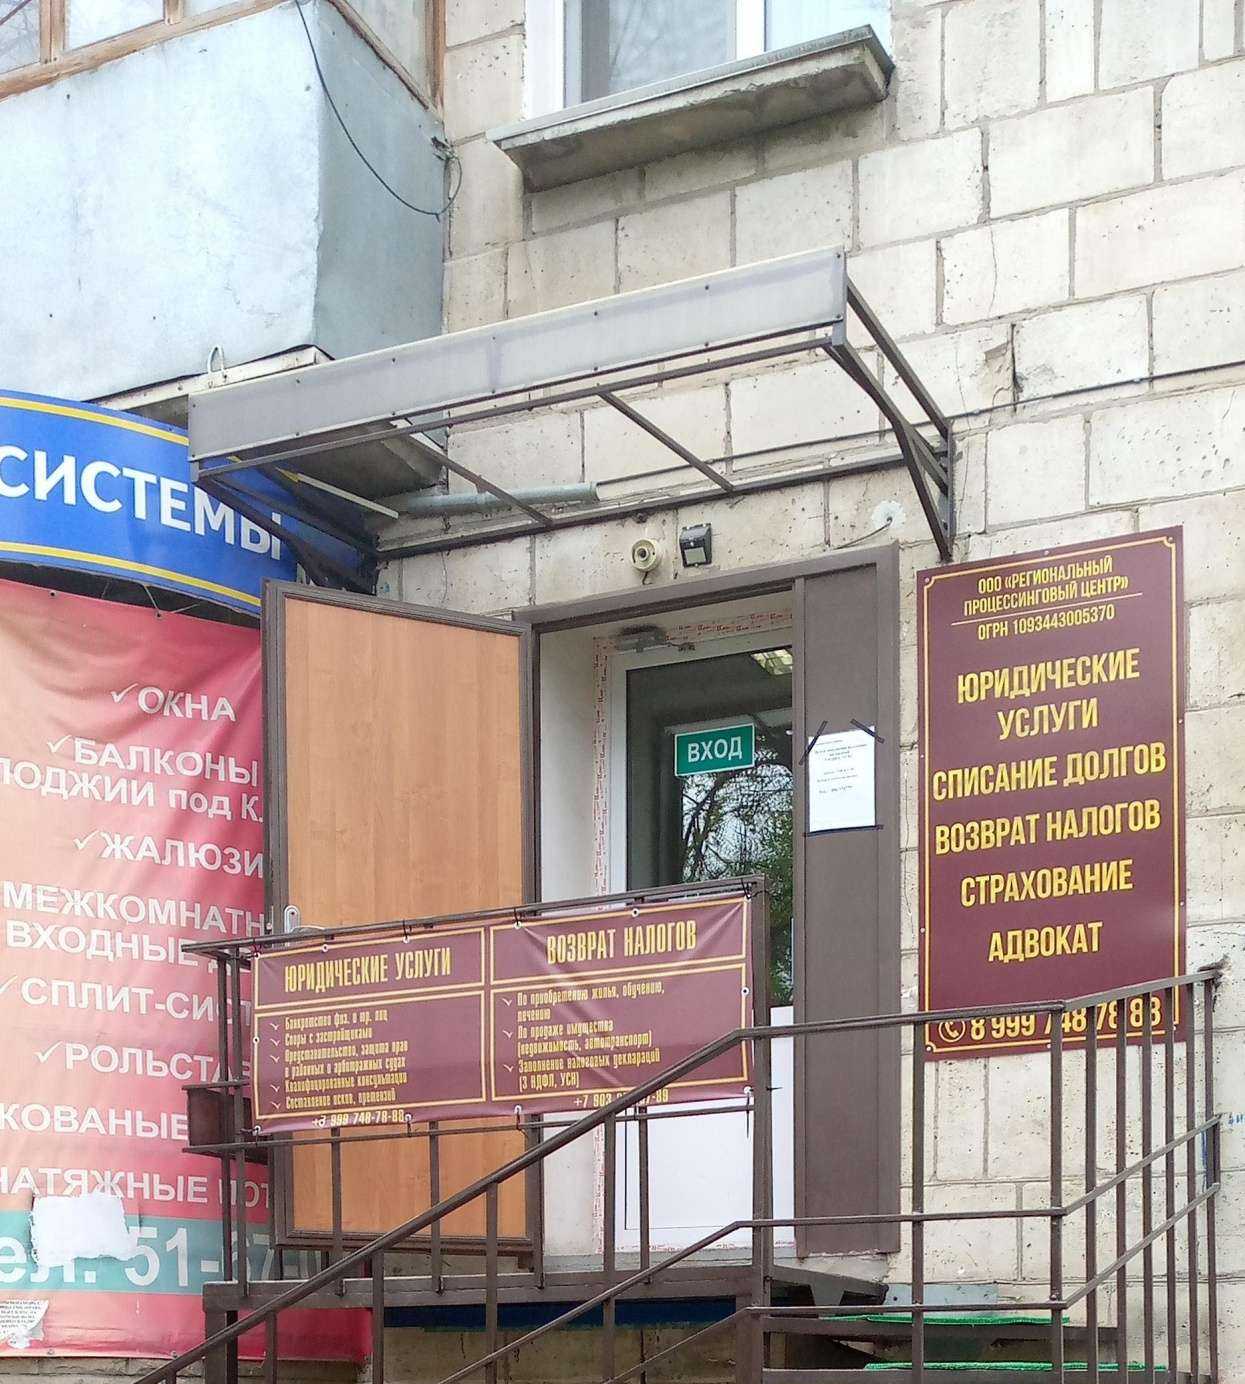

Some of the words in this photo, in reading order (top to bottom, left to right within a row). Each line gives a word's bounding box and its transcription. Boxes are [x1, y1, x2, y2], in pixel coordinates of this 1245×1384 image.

[0, 445, 281, 560] СИСТЕМЫ
[964, 583, 1077, 616] ПРОЦЕССИНГОВЫЙ
[1081, 575, 1129, 598] ЦЕНТР»
[978, 576, 1002, 594] ООО
[1004, 555, 1113, 589] «РЕГИОНАЛЬНЫЙ
[978, 620, 1008, 641] ОГРН
[1012, 604, 1115, 636] 1093443005370
[957, 647, 1140, 704] ЮРИДИЧЕСКИЕ
[138, 686, 236, 721] ОКНА
[998, 698, 1099, 741] УСЛУГИ
[75, 737, 258, 787] БАЛКОНЫ
[687, 736, 743, 763] ВХОД
[932, 756, 1058, 802] СПИСАНИЕ
[1063, 741, 1167, 788] ДОЛГОВ
[168, 787, 232, 820] под
[935, 813, 1040, 856] ВОЗВРАТ
[1046, 799, 1161, 843] НАЛОГОВ
[101, 832, 263, 878] ЖАЛЮЗИ
[960, 858, 1133, 908] СТРАХОВАНИЕ
[6, 919, 198, 966] ВХОДНЫЕ
[547, 930, 616, 964] ВОЗВРАТ
[624, 920, 697, 956] НАЛОГОВ
[988, 921, 1103, 963] АДВОКАТ
[285, 955, 388, 993] ЮРИДИЧЕСКИЕ
[395, 948, 451, 980] УСЛУГИ
[517, 992, 527, 1006] По
[530, 1023, 563, 1040] продаже
[567, 1019, 614, 1037] имущества
[970, 1017, 986, 1040] 8
[0, 1104, 187, 1140] КОВАНЫЕ
